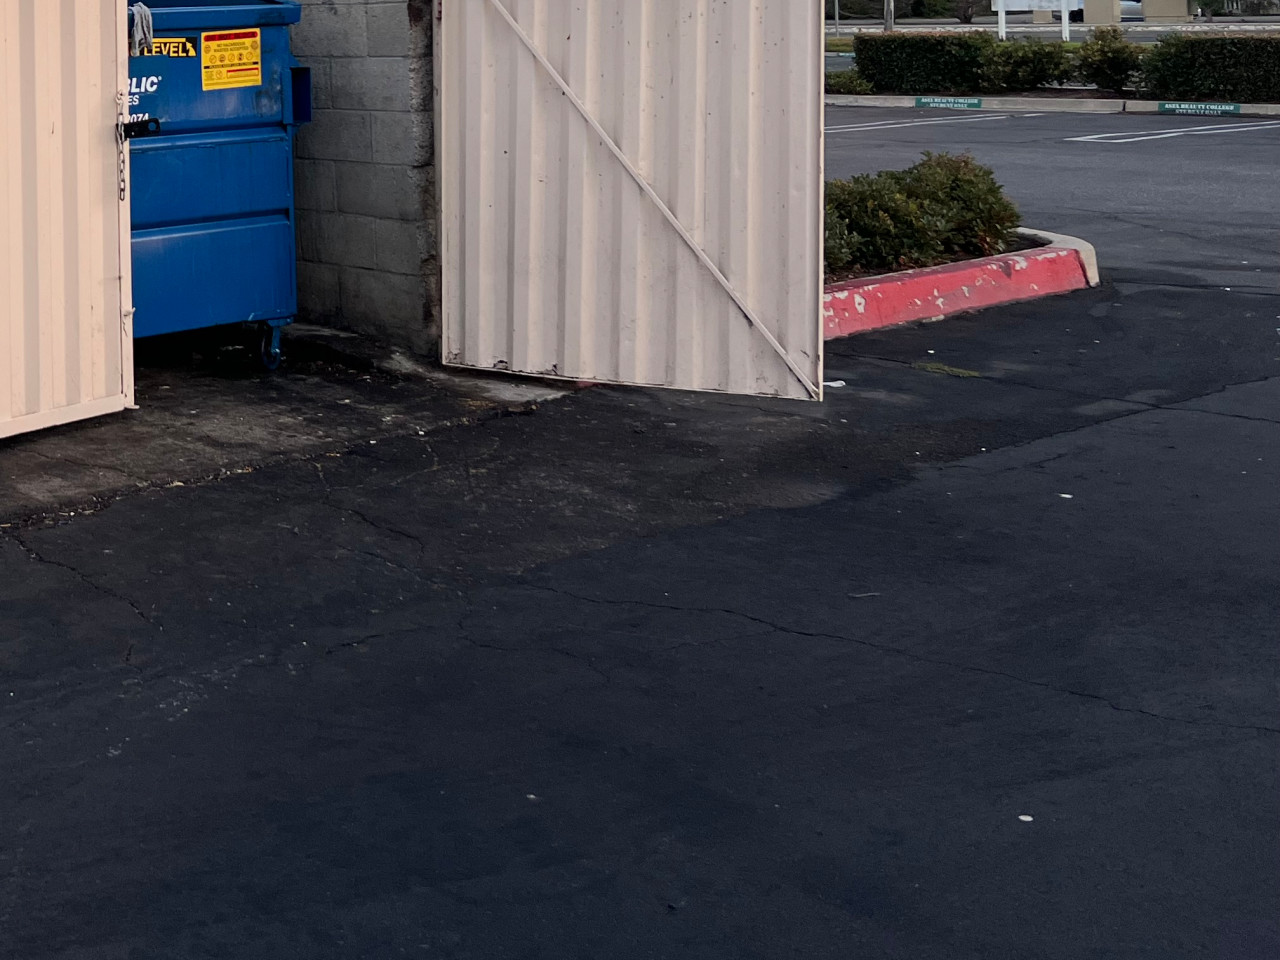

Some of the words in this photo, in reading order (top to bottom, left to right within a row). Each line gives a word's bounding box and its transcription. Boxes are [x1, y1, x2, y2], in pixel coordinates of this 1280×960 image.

[144, 43, 187, 57] LEVEL
[128, 76, 159, 93] LIC
[128, 112, 149, 123] 074
